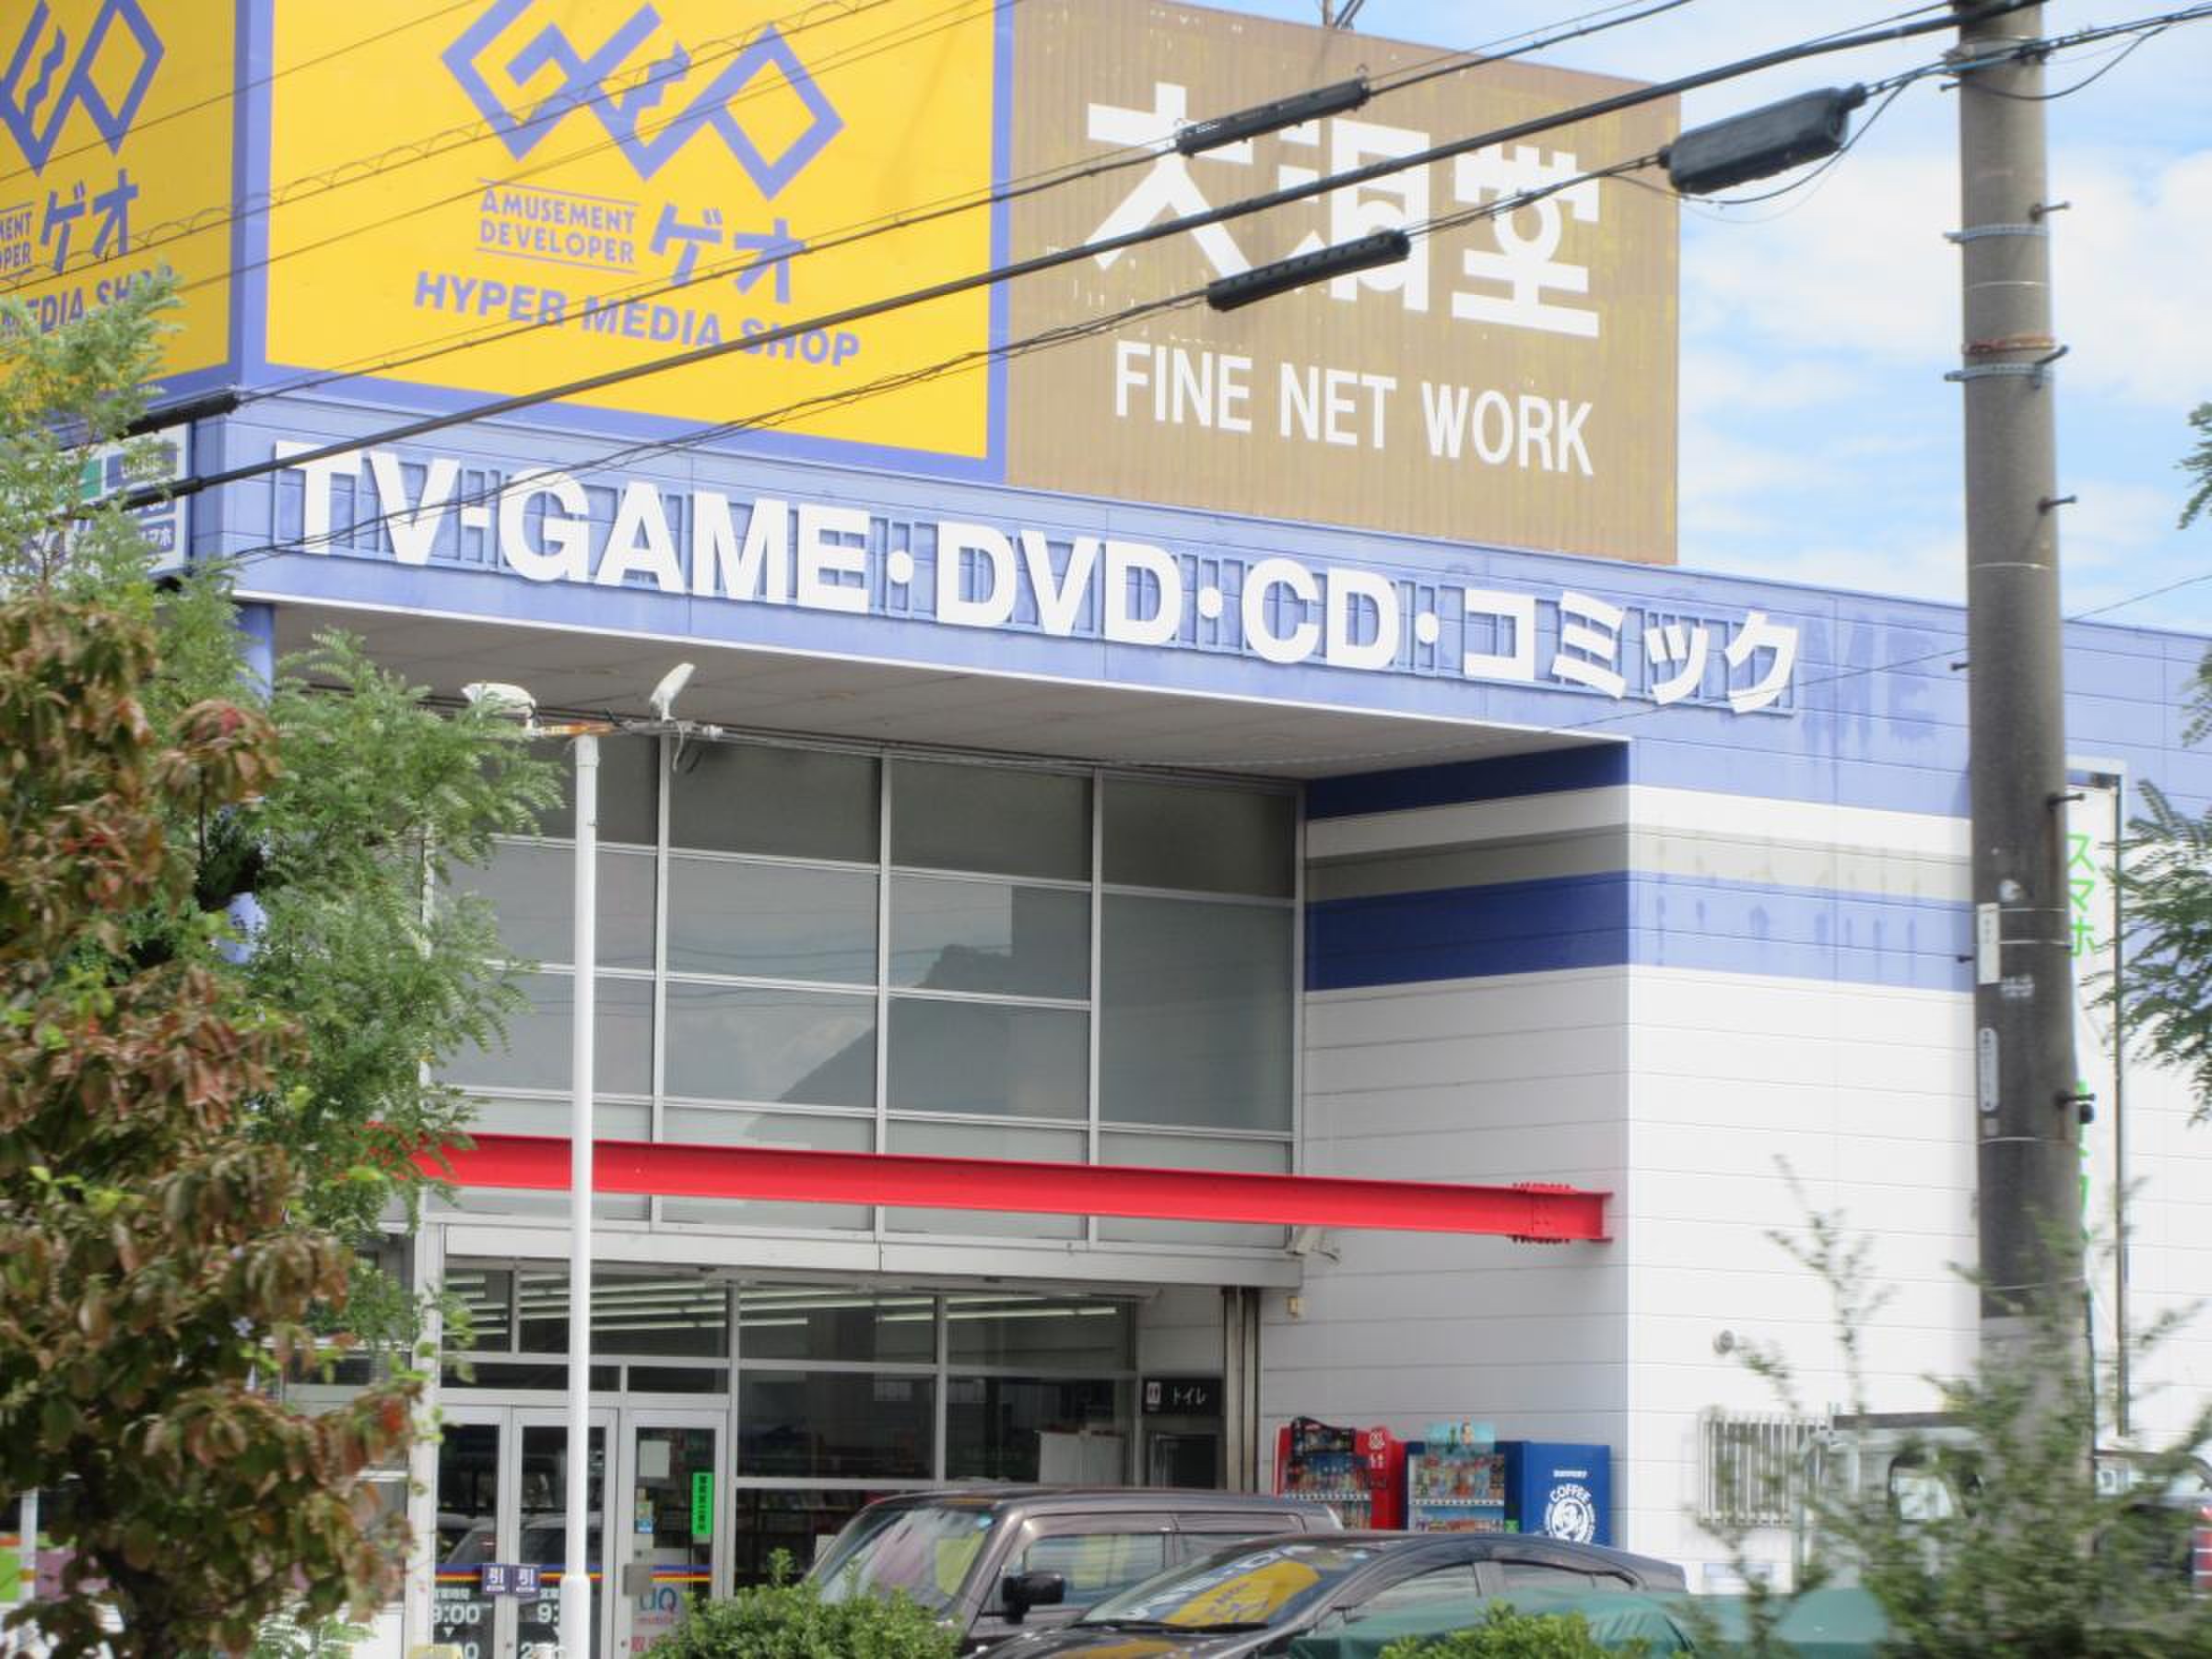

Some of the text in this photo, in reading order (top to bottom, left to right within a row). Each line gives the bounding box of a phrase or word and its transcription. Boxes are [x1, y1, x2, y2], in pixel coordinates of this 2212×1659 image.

[41, 167, 138, 276] ゲオ
[480, 189, 637, 234] AMUSEMENT
[480, 218, 635, 265] DEVELOPER
[649, 203, 806, 304] ゲオ
[414, 270, 861, 367] HYPER MEDIA SHOP
[1115, 340, 1593, 476] FINE NET WORK
[1464, 588, 1799, 715] コミック
[2065, 832, 2096, 958] スマホ
[1173, 1385, 1207, 1406] トイレ
[1549, 1483, 1592, 1502] COFFEE
